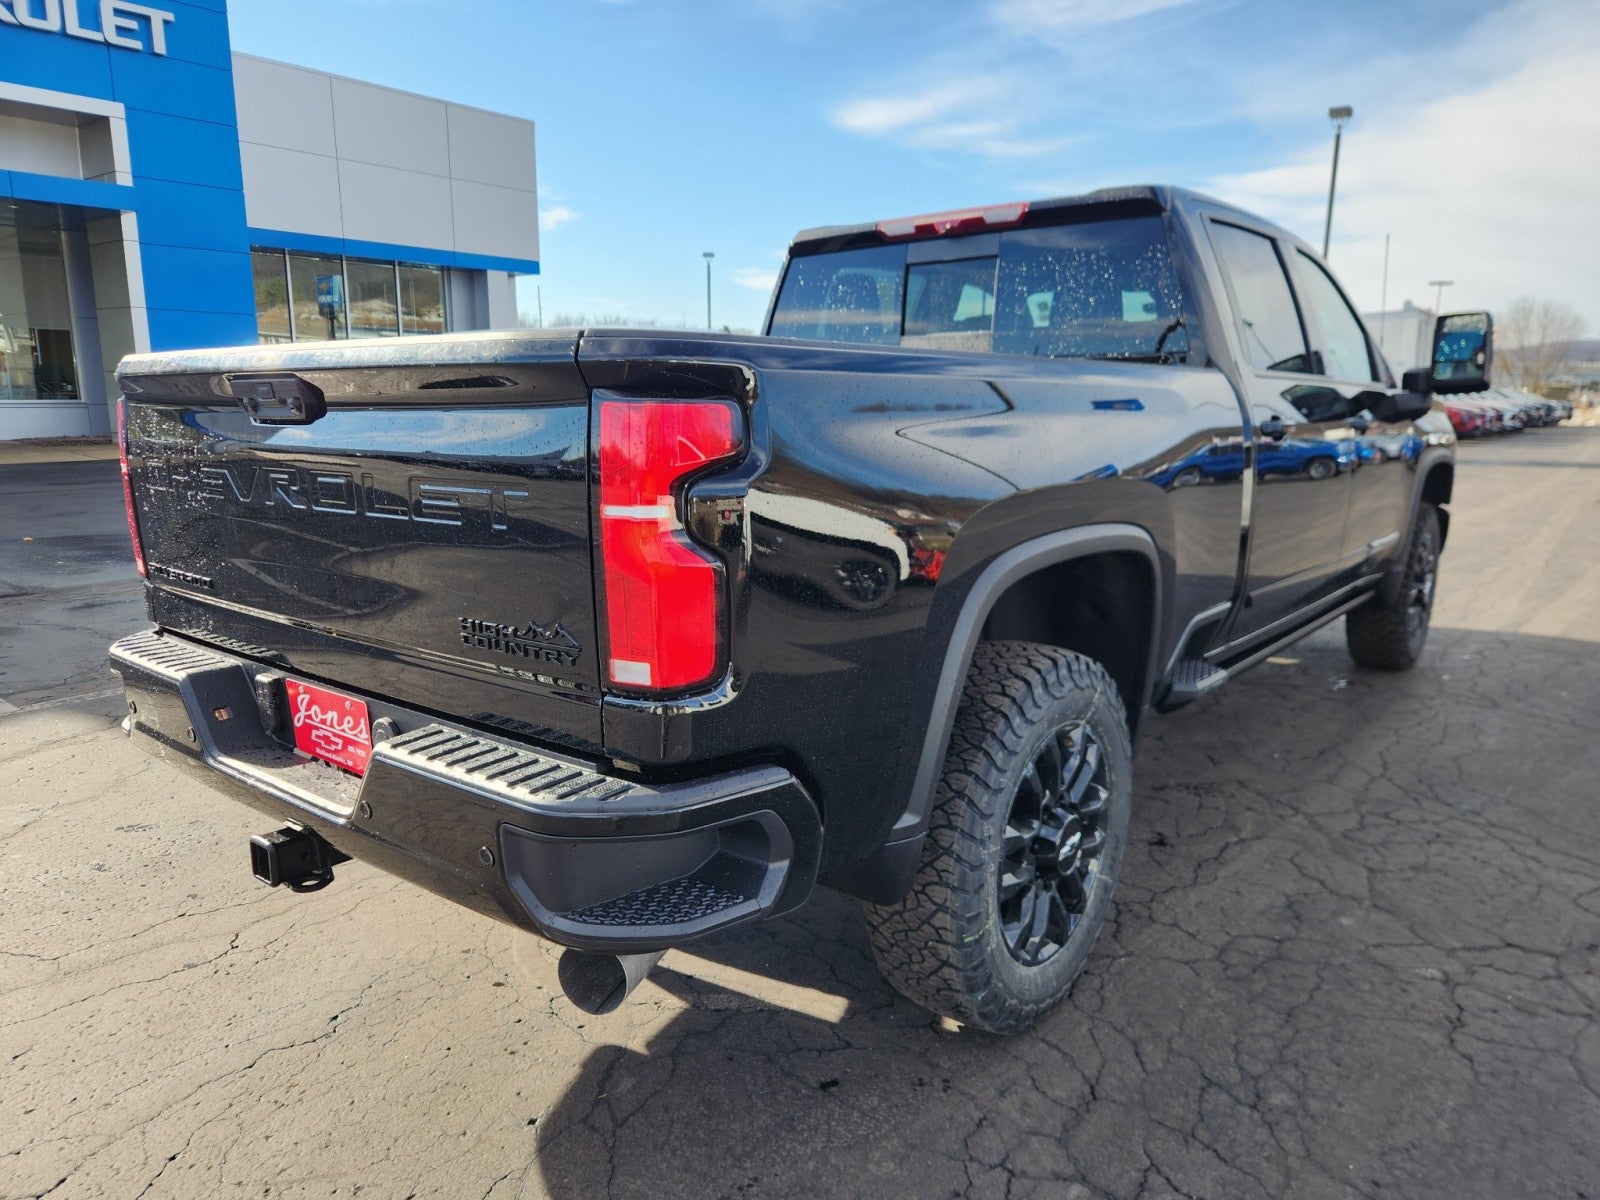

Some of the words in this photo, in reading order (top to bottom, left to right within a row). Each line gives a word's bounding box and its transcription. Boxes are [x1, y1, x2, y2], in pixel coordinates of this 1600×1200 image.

[458, 617, 519, 638] HIGH
[460, 632, 581, 666] COUNTRY
[294, 694, 369, 739] Jones
